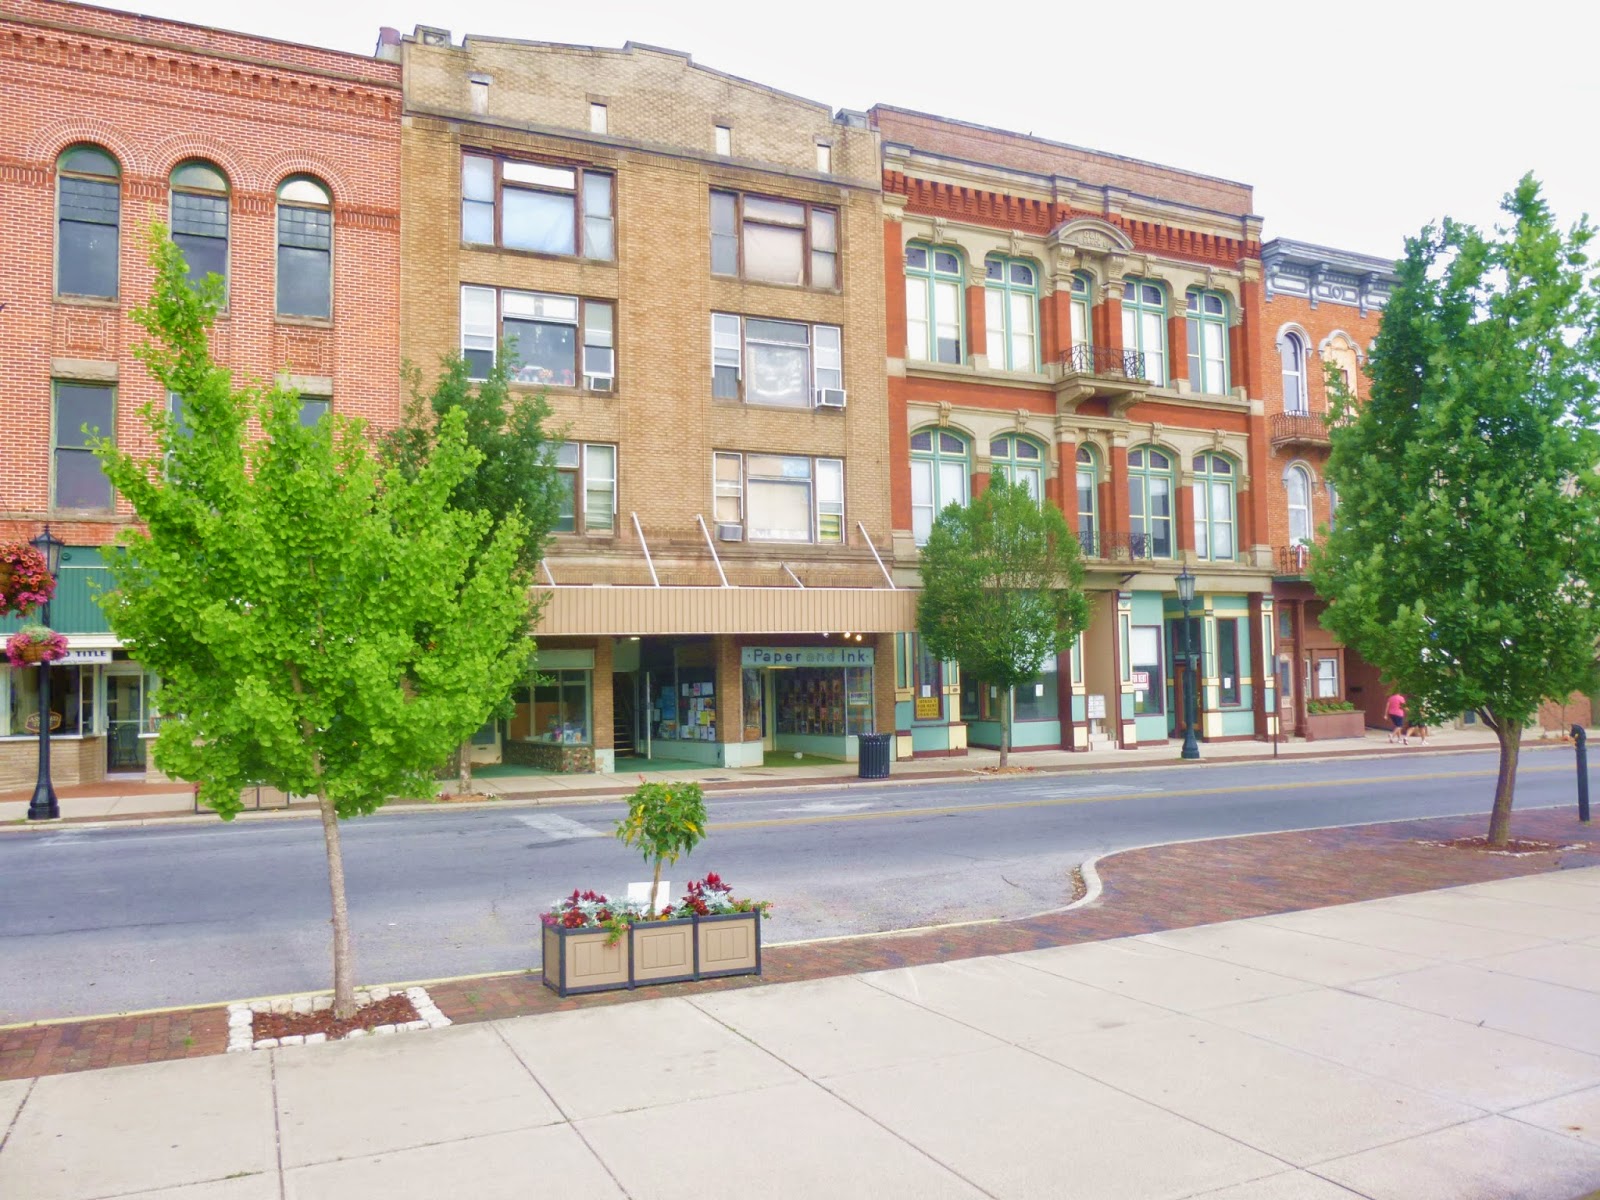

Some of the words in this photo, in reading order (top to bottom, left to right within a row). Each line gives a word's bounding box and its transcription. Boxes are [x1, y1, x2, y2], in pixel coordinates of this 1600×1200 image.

[753, 649, 802, 664] Paper
[806, 649, 835, 662] and
[841, 649, 865, 662] Ink
